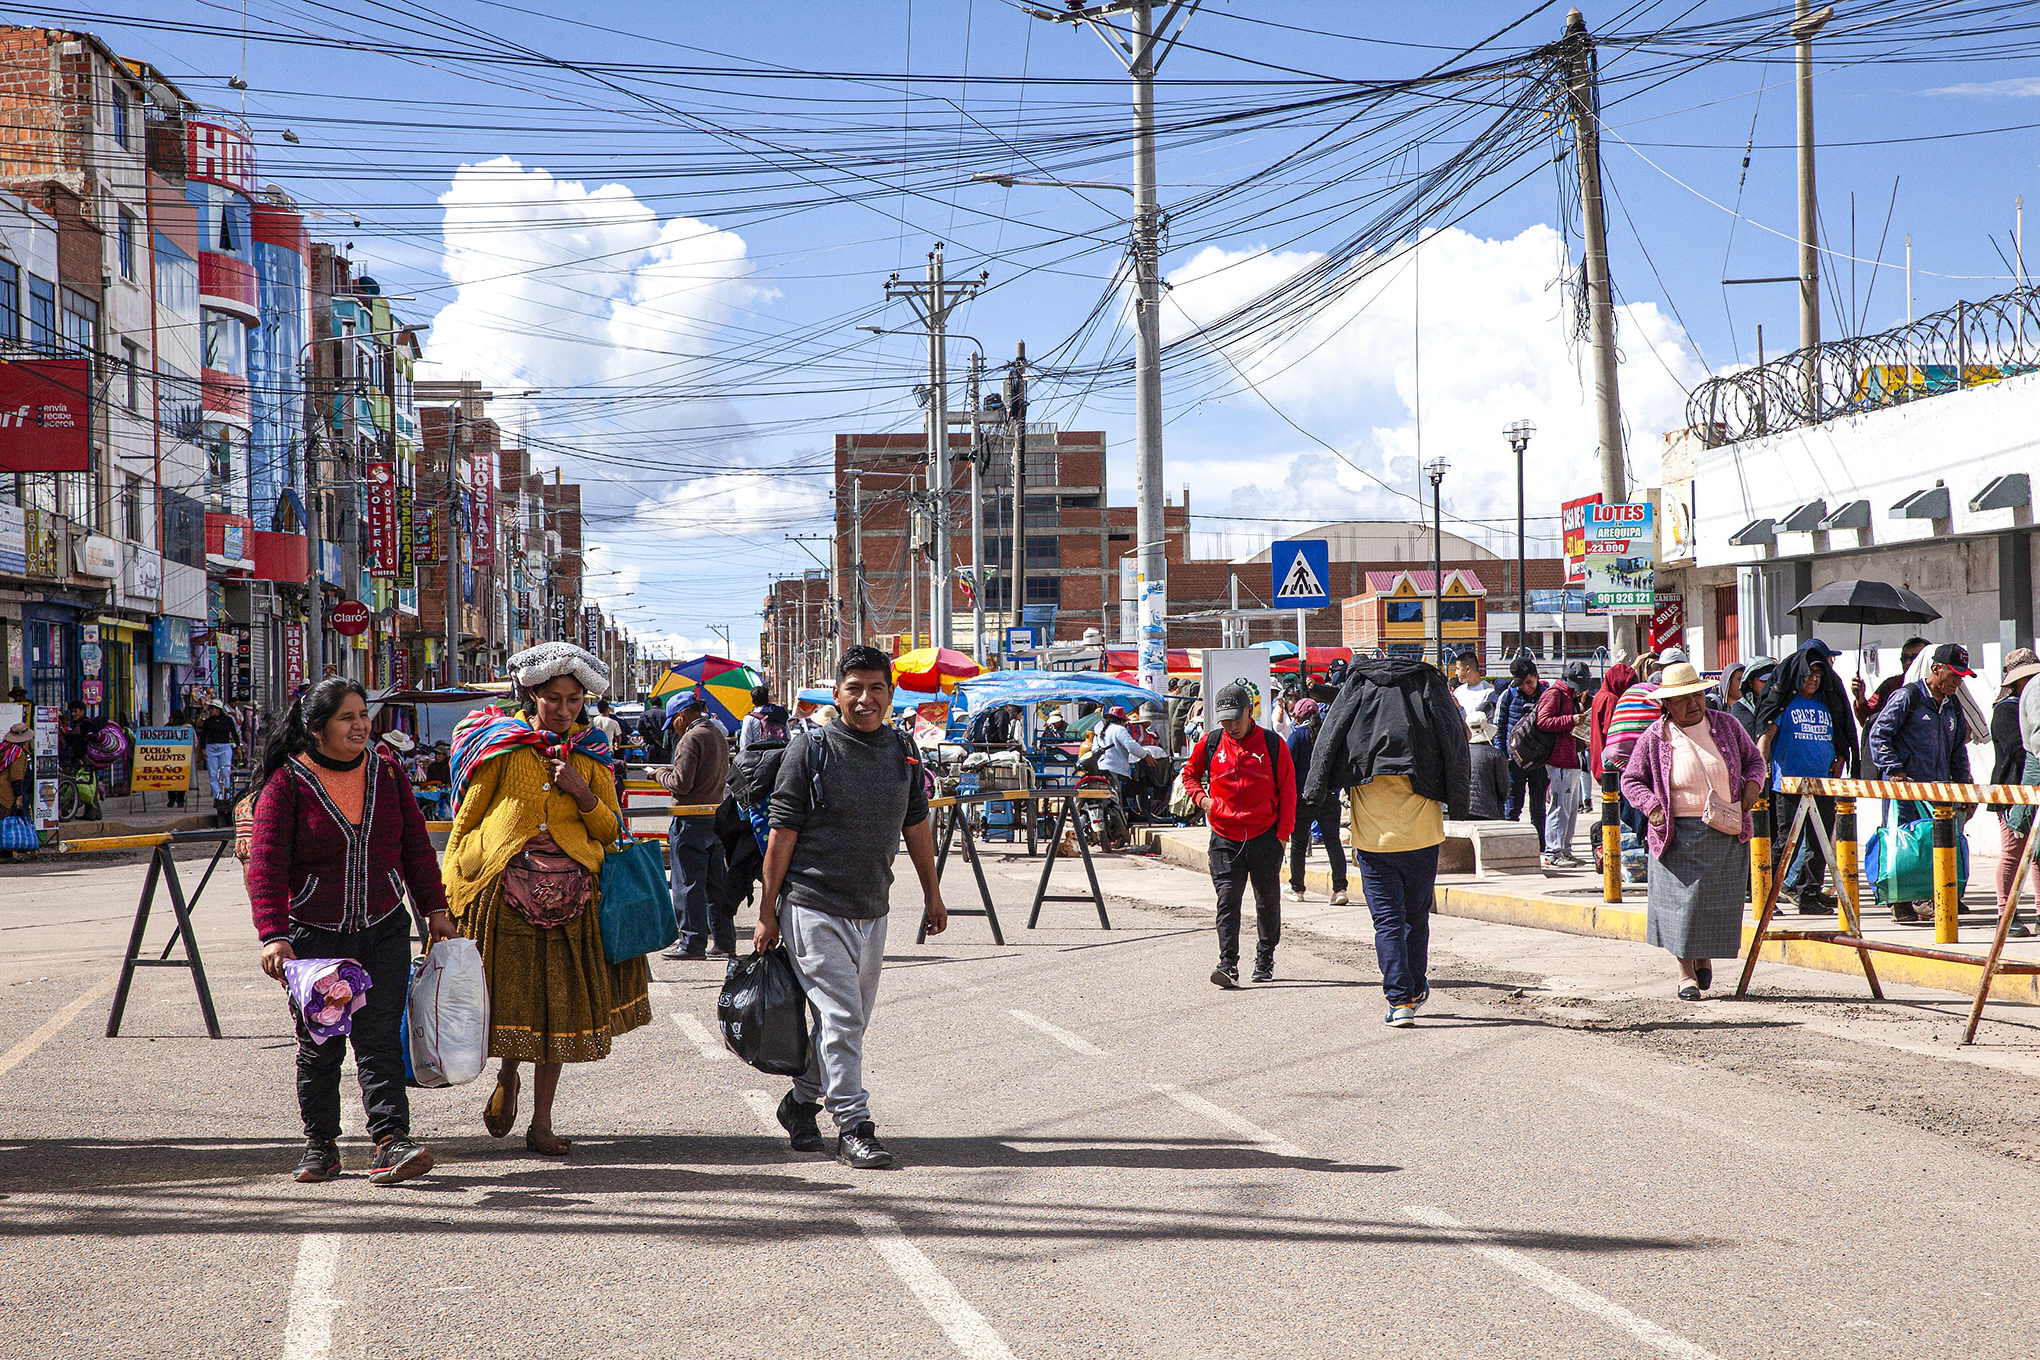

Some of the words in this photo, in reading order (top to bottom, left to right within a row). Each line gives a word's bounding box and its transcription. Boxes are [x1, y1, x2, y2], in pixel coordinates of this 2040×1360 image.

[43, 404, 67, 412] envía
[43, 412, 71, 420] recibe
[474, 456, 489, 549] HOSTAL
[1593, 505, 1644, 522] LOTES
[371, 485, 382, 569] POLLERIA
[401, 488, 412, 573] HOSPEDAJE
[1597, 527, 1642, 539] AREQUIPA
[27, 513, 37, 573] BOTICA
[1598, 594, 1614, 603] 901
[1616, 593, 1634, 603] 926
[1635, 592, 1650, 603] 121
[333, 612, 363, 622] Claro
[556, 594, 565, 642] HOSTAL
[1656, 603, 1679, 625] SOLES
[287, 629, 301, 680] HOSTAL
[1791, 709, 1815, 724] GRACE
[140, 729, 189, 741] HOSPEDAJE
[140, 746, 171, 754] DUCHAS
[144, 754, 186, 762] CALIENTES
[142, 764, 182, 774] BAÑO
